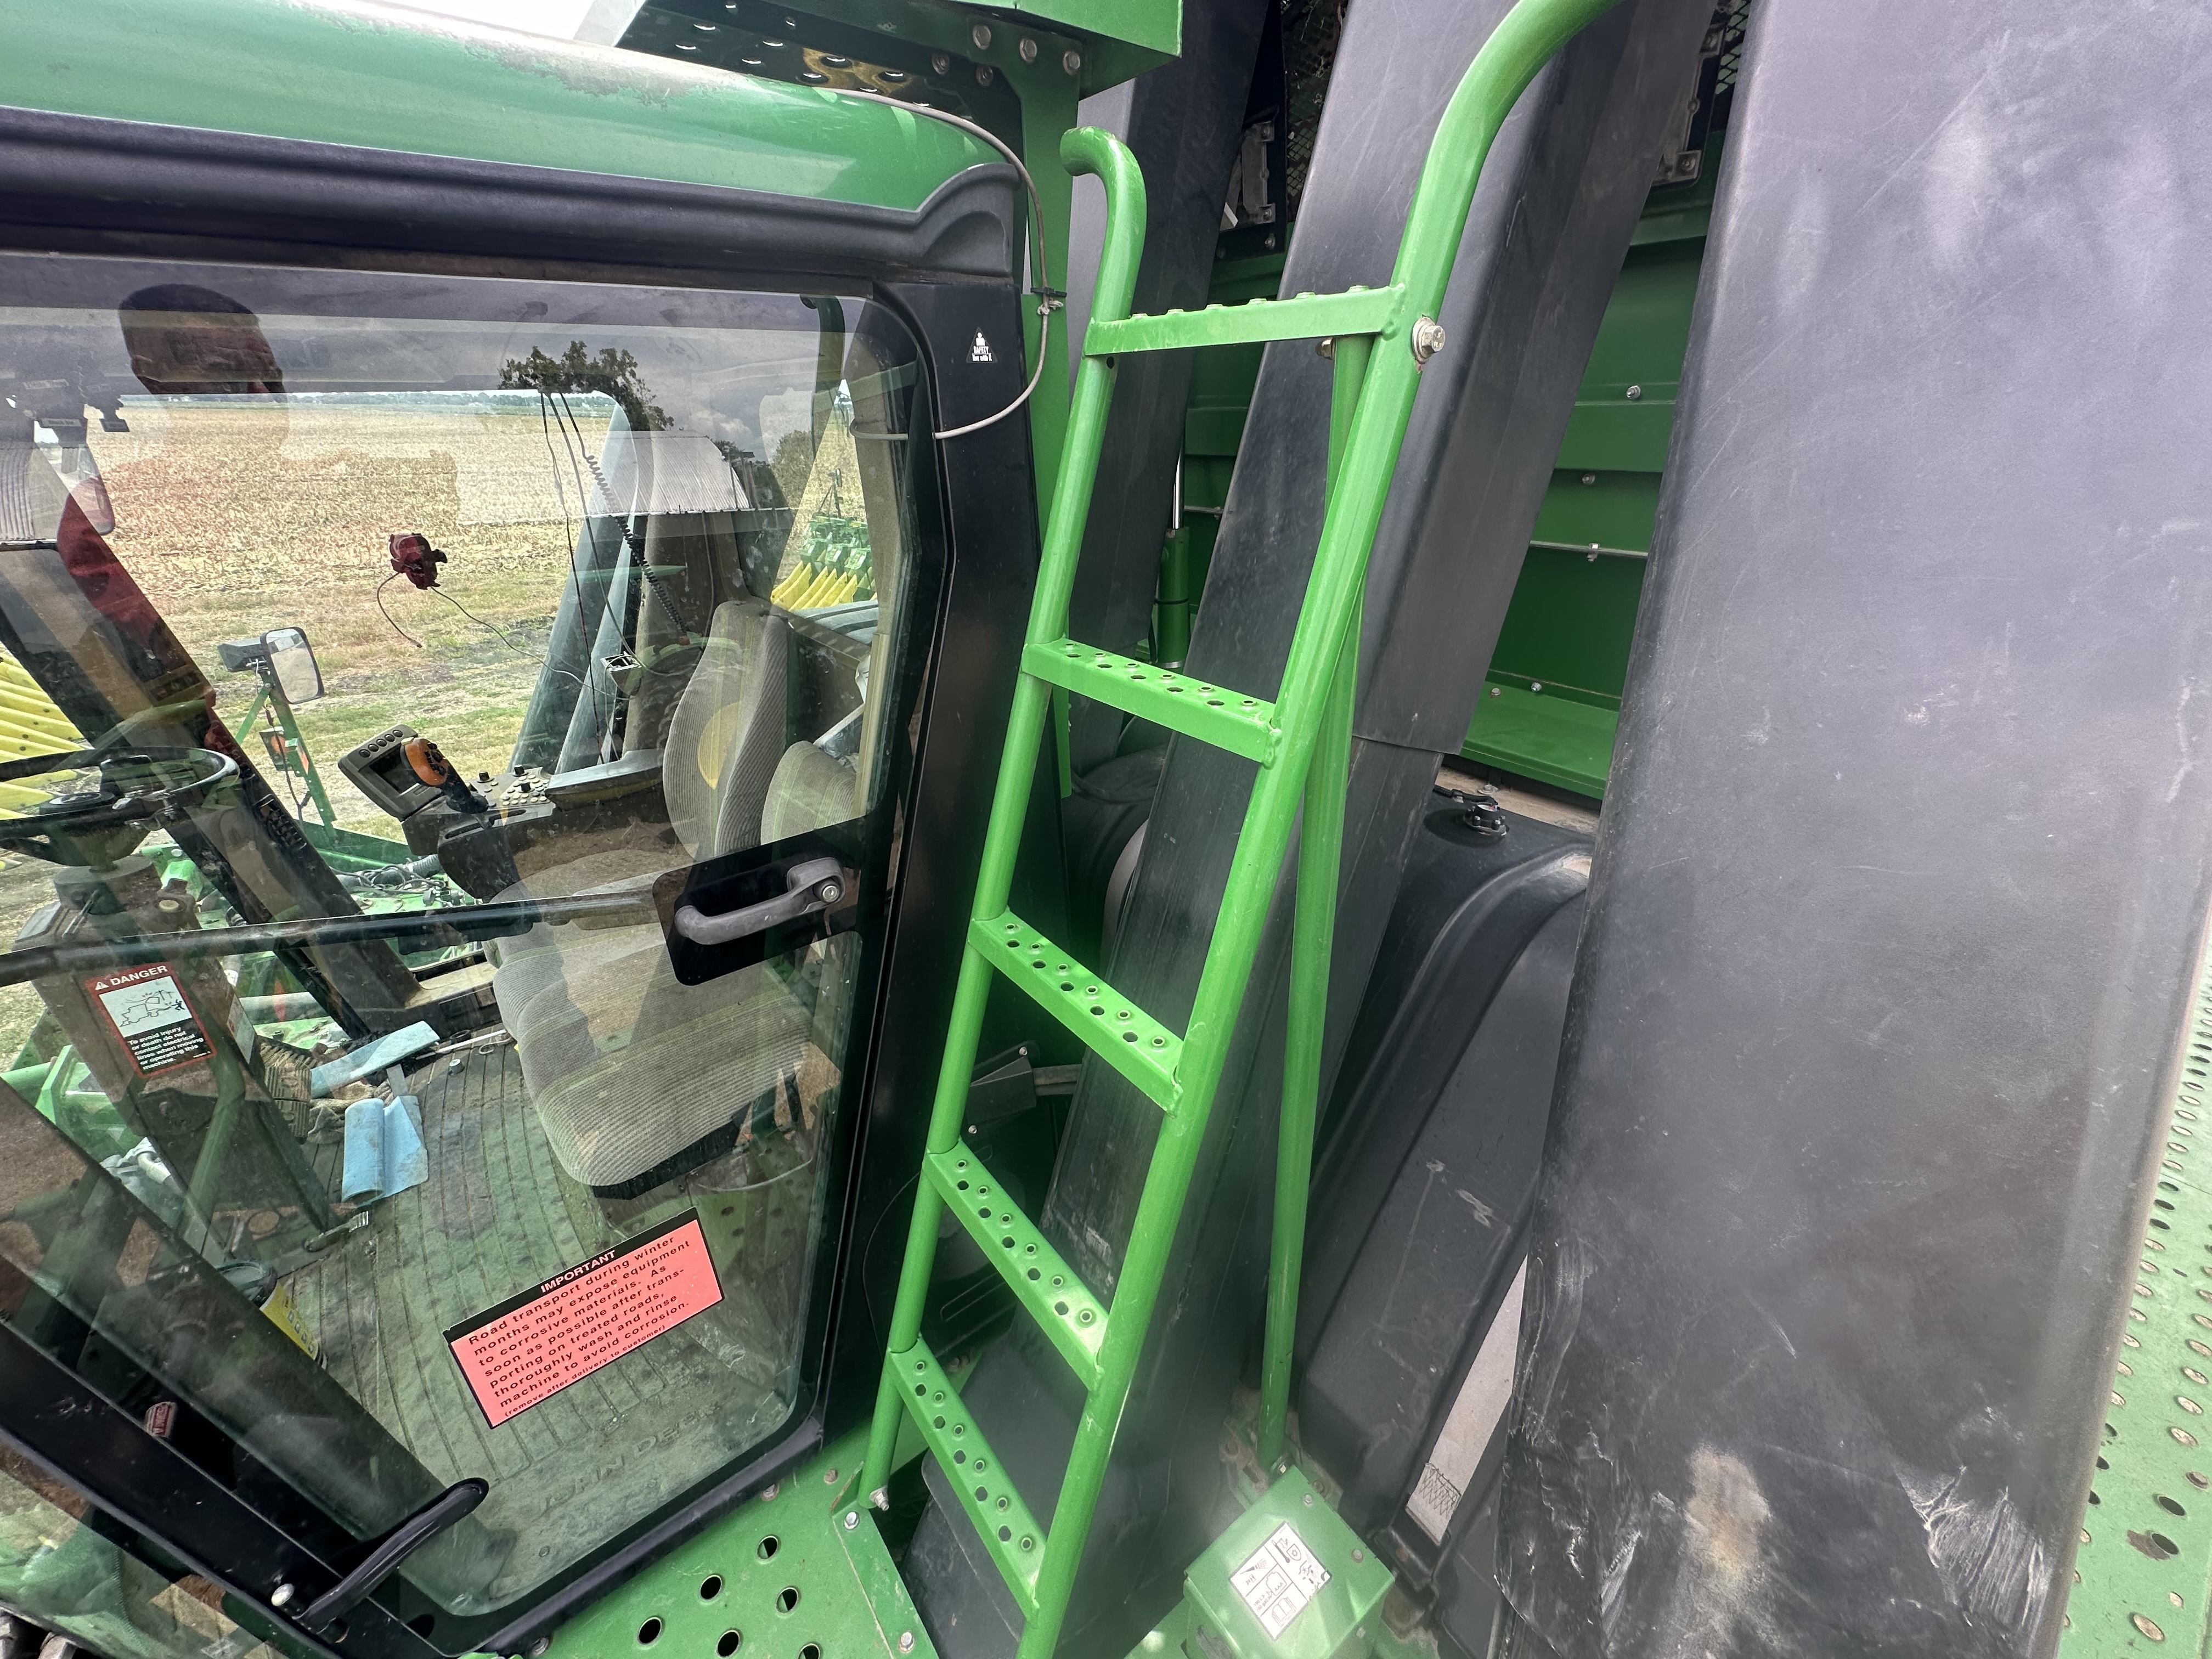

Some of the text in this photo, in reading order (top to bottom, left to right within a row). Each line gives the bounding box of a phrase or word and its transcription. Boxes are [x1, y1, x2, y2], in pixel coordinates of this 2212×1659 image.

[110, 966, 168, 985] DANGER
[134, 1034, 195, 1055] contact electrical
[139, 1033, 160, 1042] avoid
[160, 1027, 181, 1036] injury
[141, 1039, 162, 1047] death
[150, 1049, 184, 1062] operating
[156, 1046, 176, 1054] when
[177, 1037, 204, 1048] moving
[469, 1237, 673, 1345] Road transport during winter
[475, 1241, 689, 1356] months may expose equipment
[479, 1266, 665, 1365] to corrosive materials. As
[541, 1250, 615, 1293] IMPORTANT
[485, 1269, 684, 1376] soon as possible after trans-
[490, 1294, 663, 1389] porting on treated roads,
[494, 1296, 676, 1397] thoroughly wash and rinse
[500, 1304, 689, 1407] machine to avoid corrosion.
[505, 1393, 543, 1417] (remove
[548, 1379, 567, 1393] after
[572, 1358, 607, 1379] delivery
[623, 1325, 665, 1351] customer)
